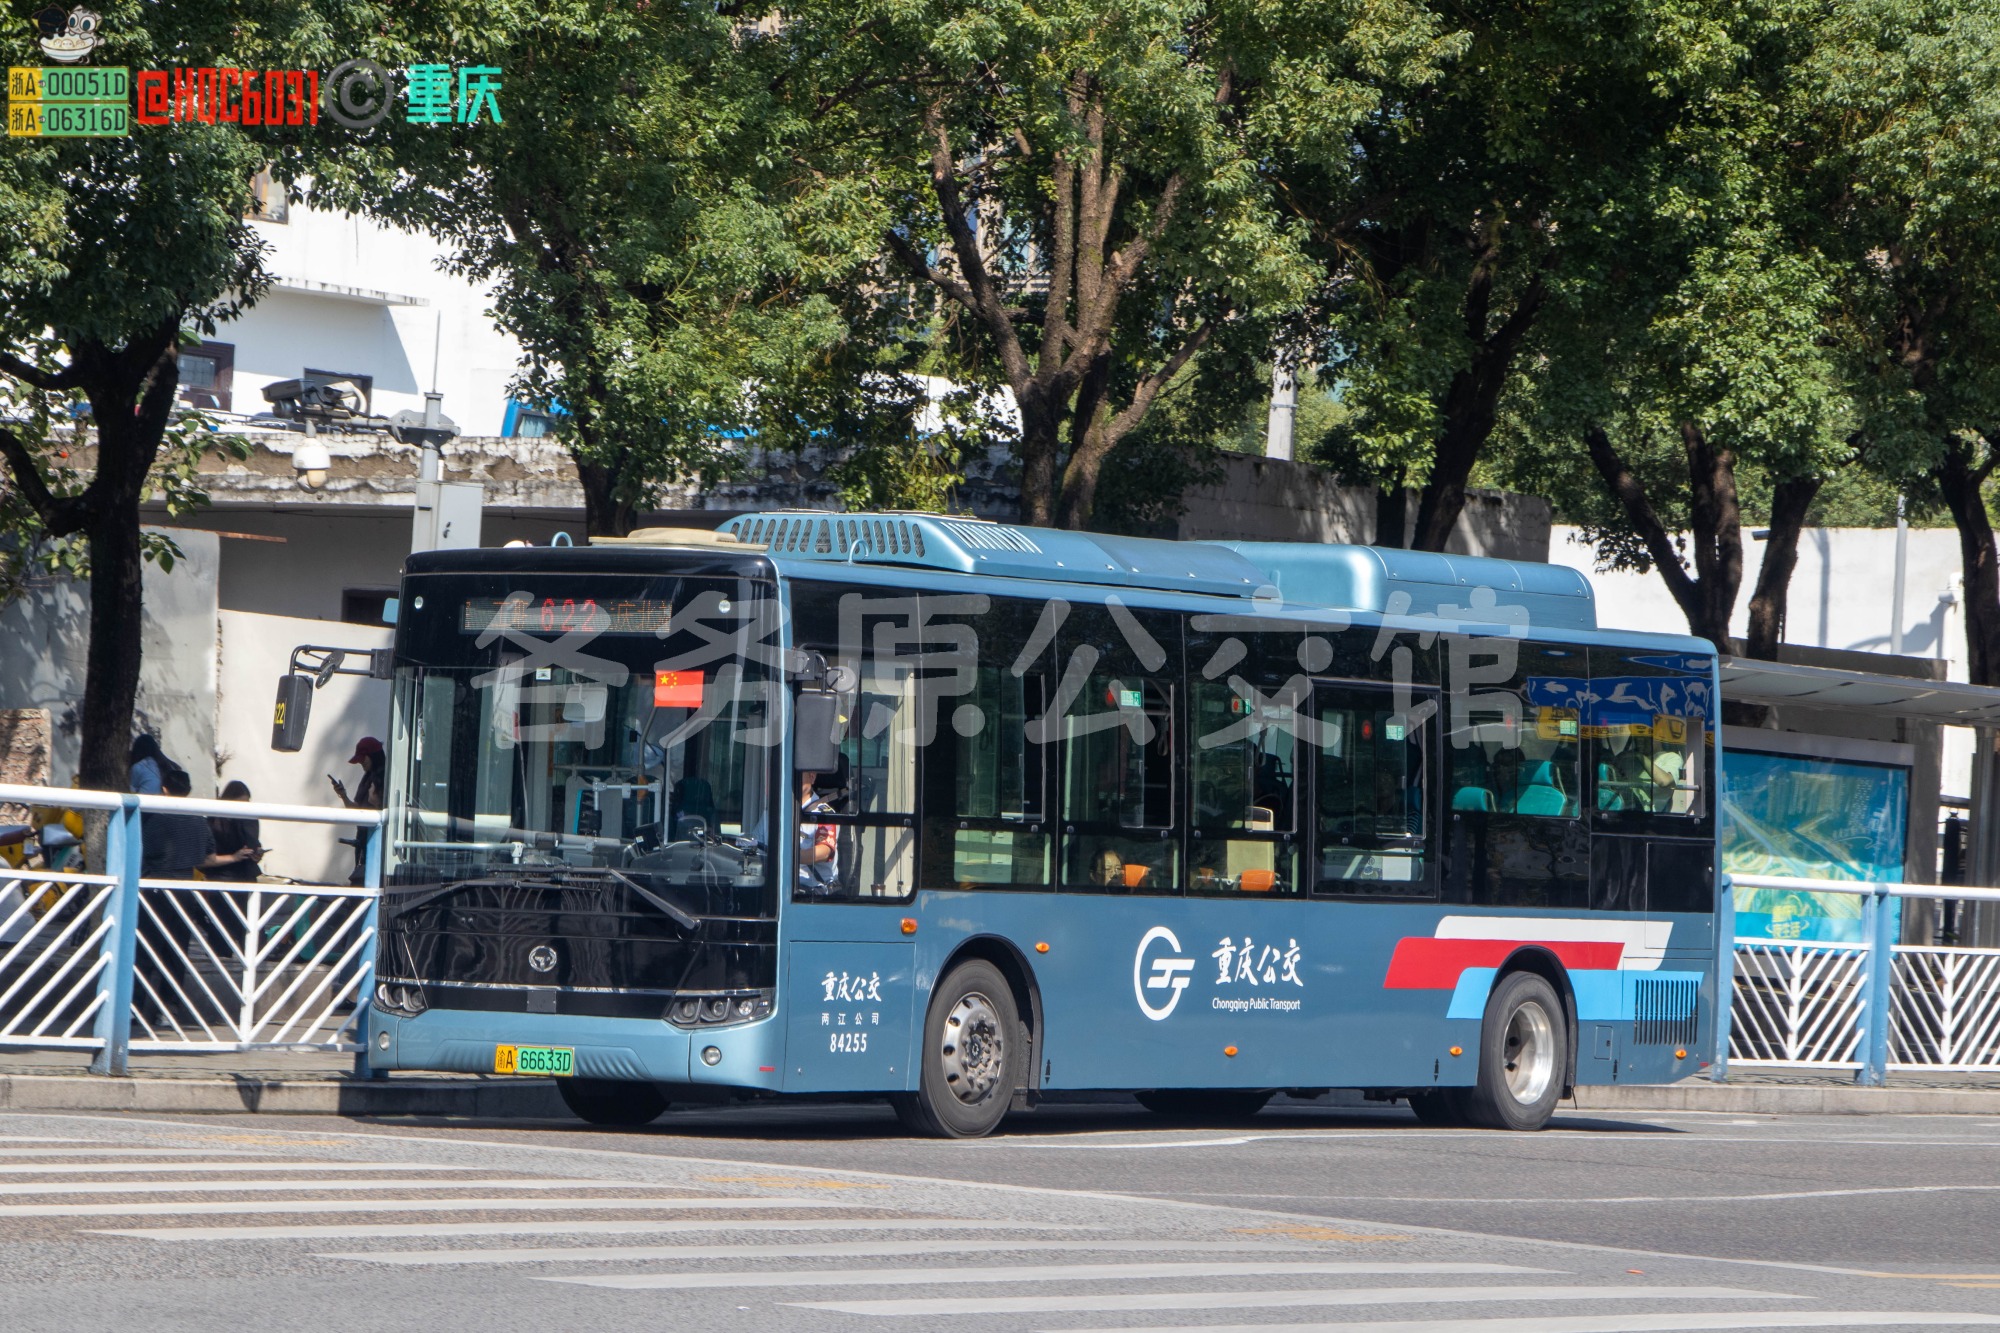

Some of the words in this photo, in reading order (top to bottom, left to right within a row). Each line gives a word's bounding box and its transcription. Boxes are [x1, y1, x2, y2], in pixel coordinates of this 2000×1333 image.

[540, 598, 597, 632] 622
[274, 702, 285, 724] 22
[1211, 936, 1304, 987] 重庆公交
[821, 971, 882, 1002] 重庆公交
[1212, 997, 1248, 1012] Chongqing
[1249, 997, 1269, 1010] Public
[1270, 998, 1301, 1013] Transport
[821, 1012, 879, 1026] 两江公司
[829, 1033, 867, 1053] 84255
